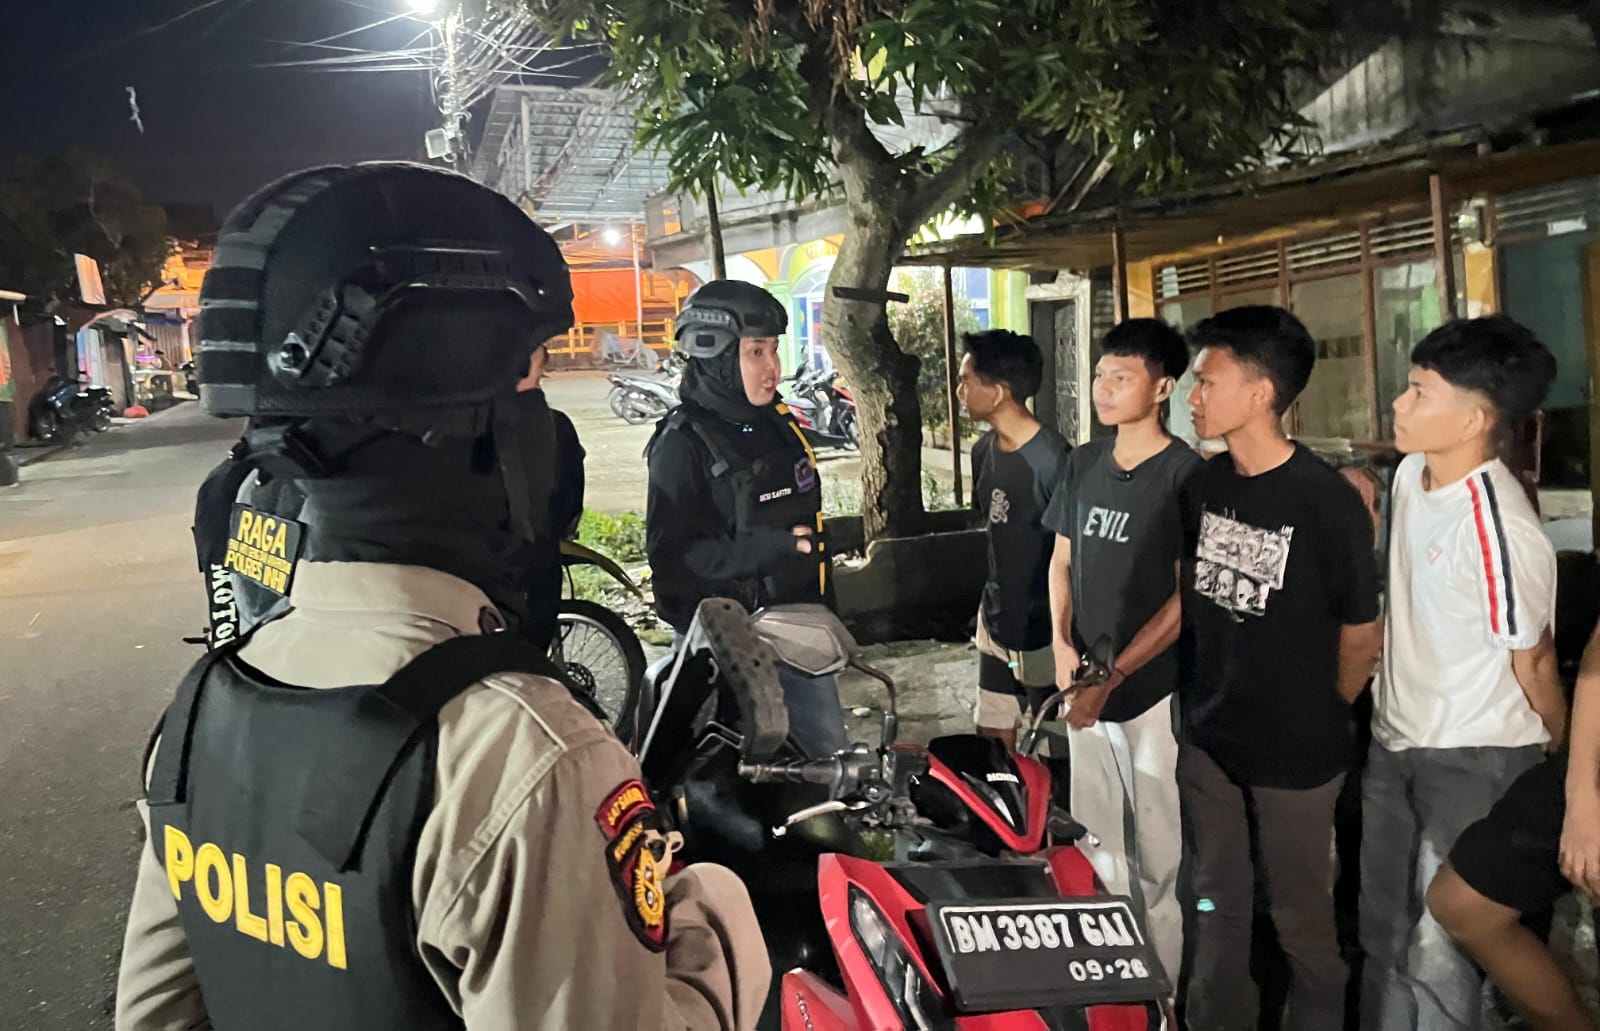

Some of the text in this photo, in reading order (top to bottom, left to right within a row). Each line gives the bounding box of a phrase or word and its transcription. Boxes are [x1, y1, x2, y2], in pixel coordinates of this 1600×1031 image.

[237, 510, 287, 558] RAGA
[1083, 506, 1130, 543] EVIL
[224, 549, 263, 581] POLRES
[164, 824, 347, 970] POLISI
[950, 915, 1001, 953] BM
[997, 914, 1074, 949] 3387
